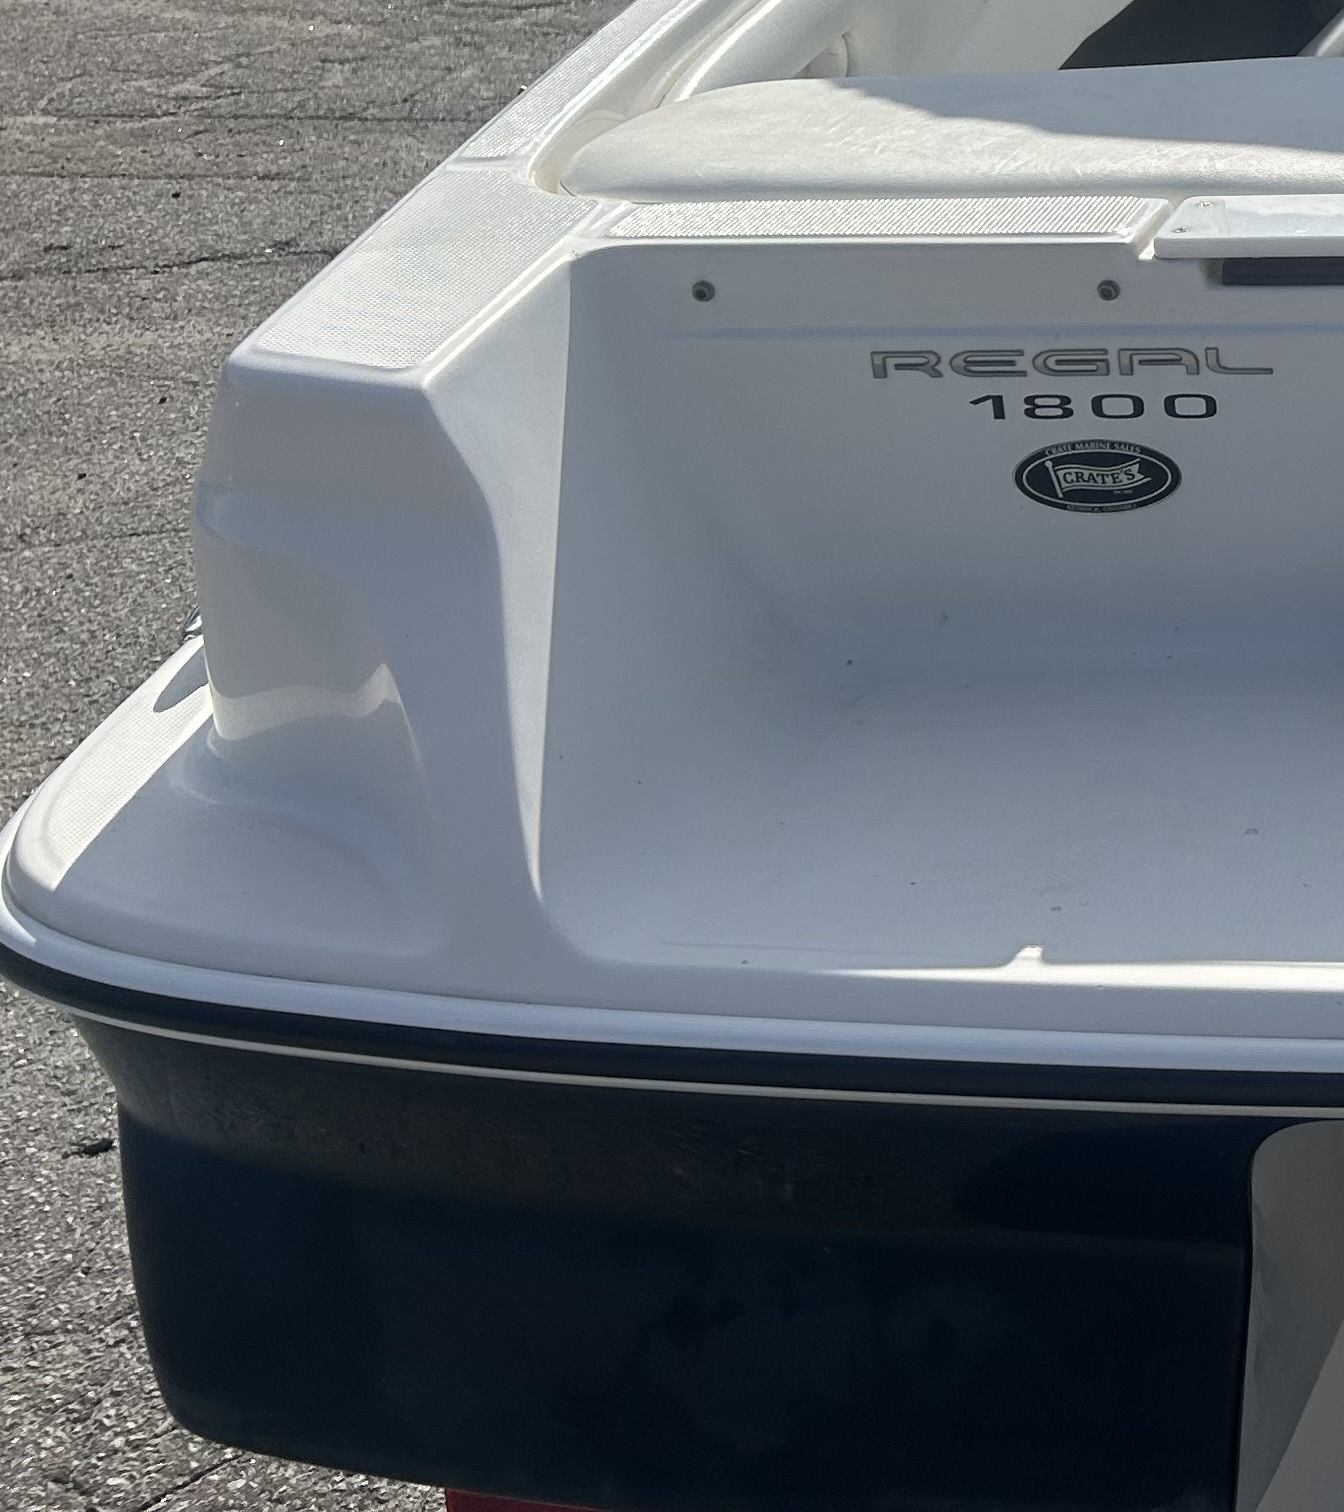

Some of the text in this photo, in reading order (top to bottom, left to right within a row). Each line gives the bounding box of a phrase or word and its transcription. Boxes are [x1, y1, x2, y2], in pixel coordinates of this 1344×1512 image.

[870, 347, 1274, 379] REGAL
[969, 393, 1218, 420] 1800
[1044, 441, 1142, 457] CRATE MARINE SALES
[1062, 468, 1136, 485] CRATE'S
